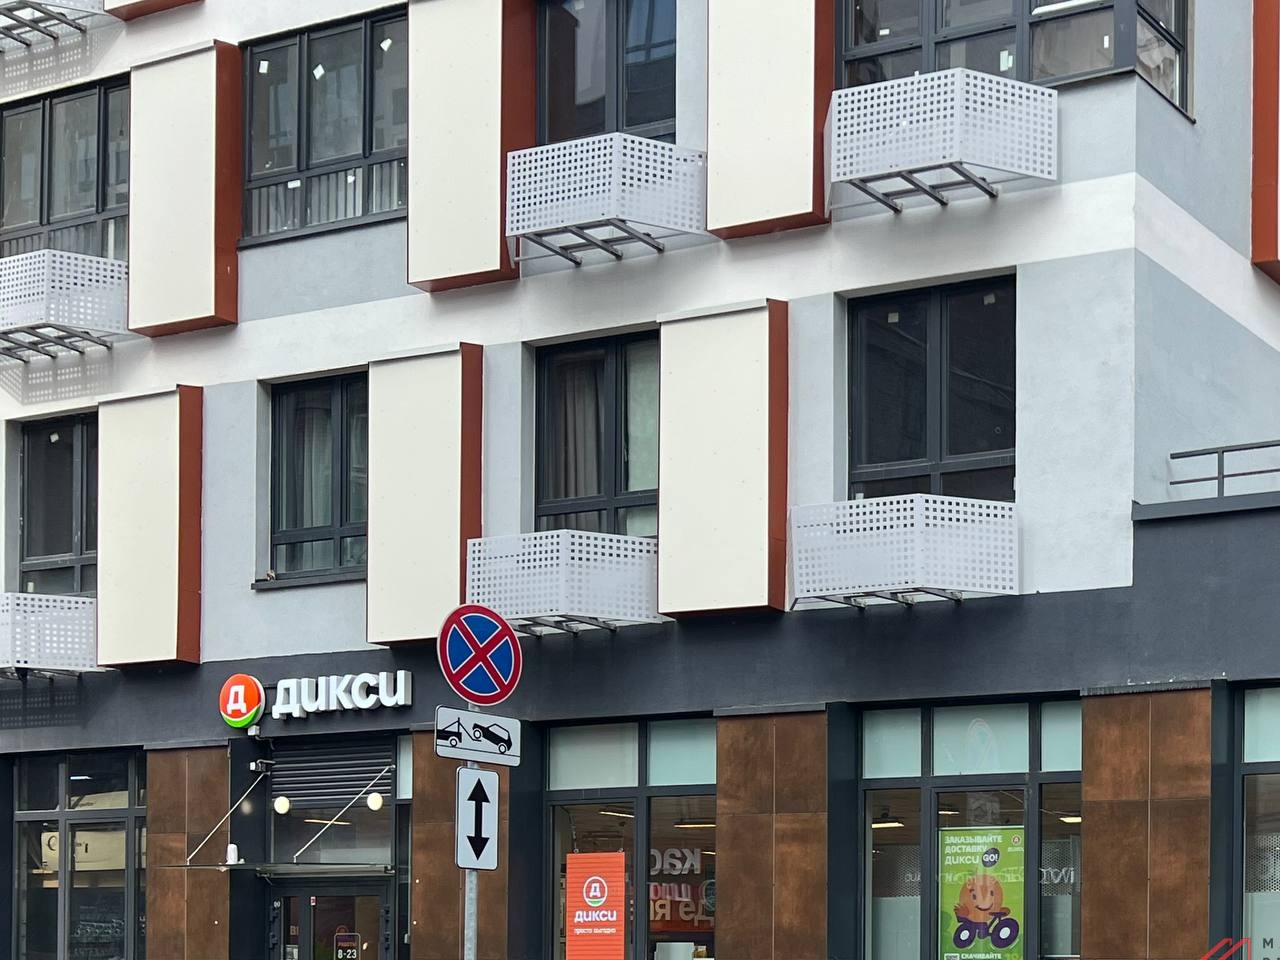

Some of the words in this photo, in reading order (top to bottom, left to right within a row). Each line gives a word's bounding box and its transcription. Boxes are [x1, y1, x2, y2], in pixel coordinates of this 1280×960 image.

[226, 684, 247, 715] Д
[982, 854, 998, 862] GO!
[337, 949, 357, 959] 8-23
